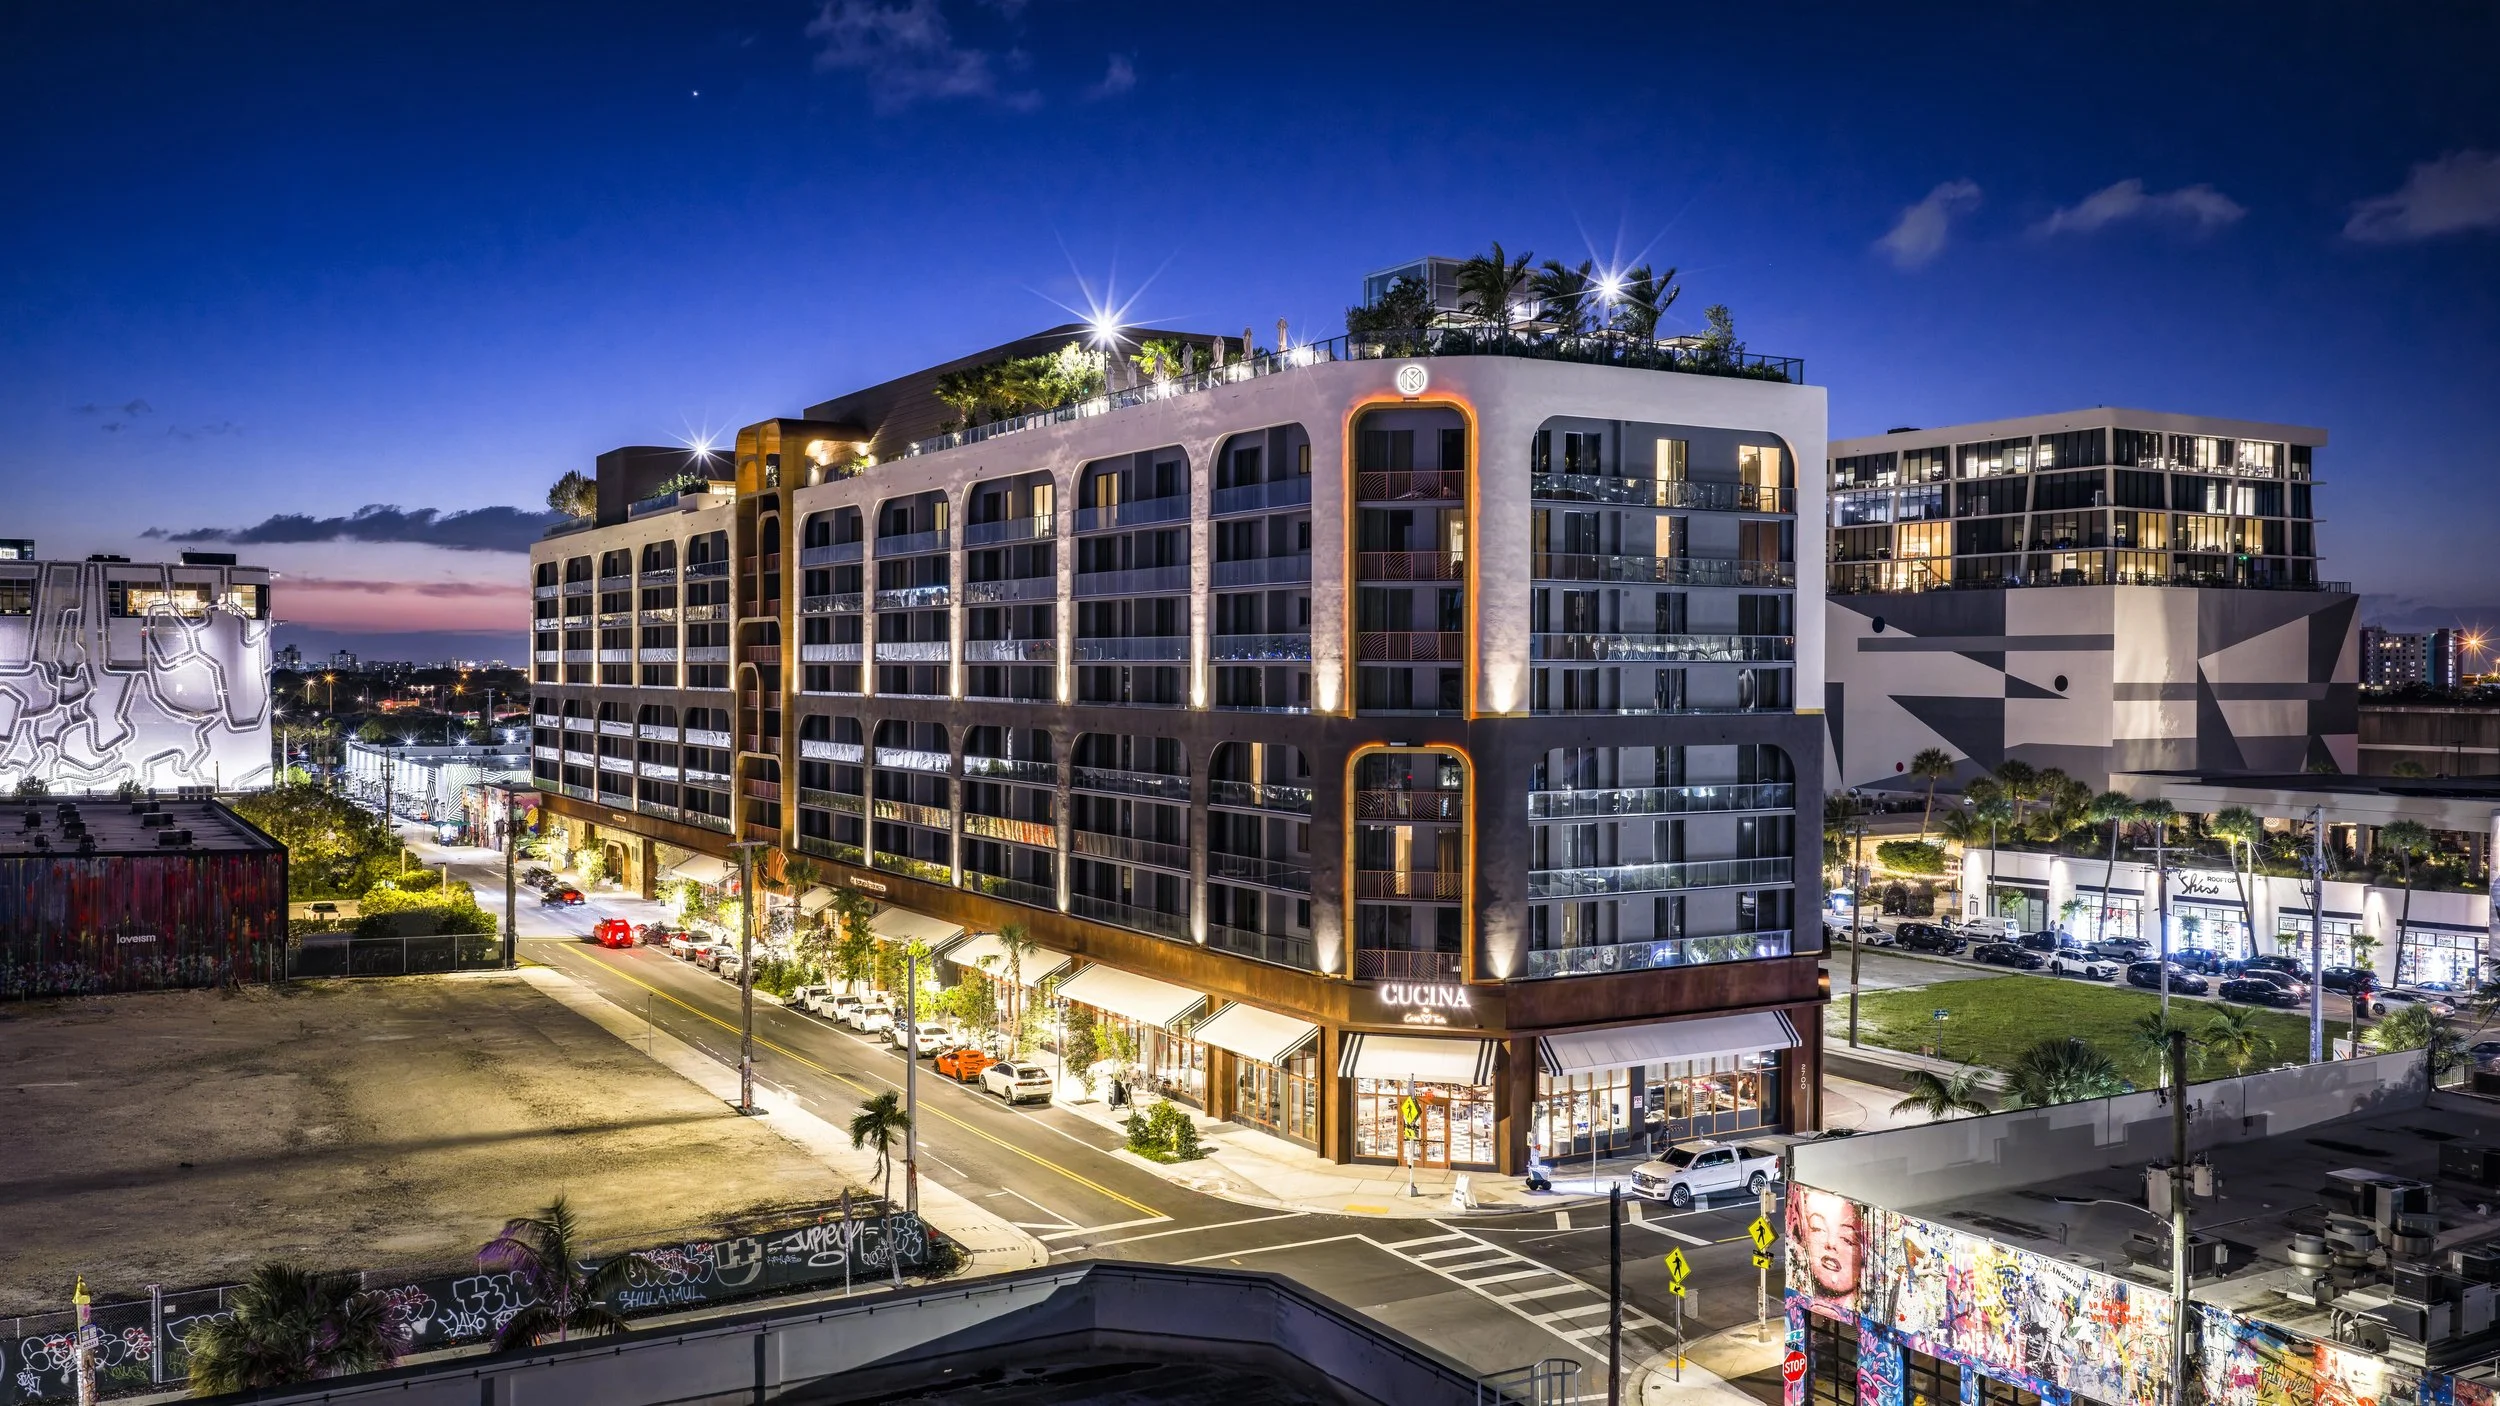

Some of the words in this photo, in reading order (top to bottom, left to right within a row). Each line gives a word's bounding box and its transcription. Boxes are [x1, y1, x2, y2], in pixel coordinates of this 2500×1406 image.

[2179, 873, 2219, 894] Shiso
[2207, 876, 2236, 884] ROOFTOP
[117, 934, 156, 944] loveism
[1381, 984, 1471, 1008] CUCINA
[1784, 1358, 1805, 1374] STOP
